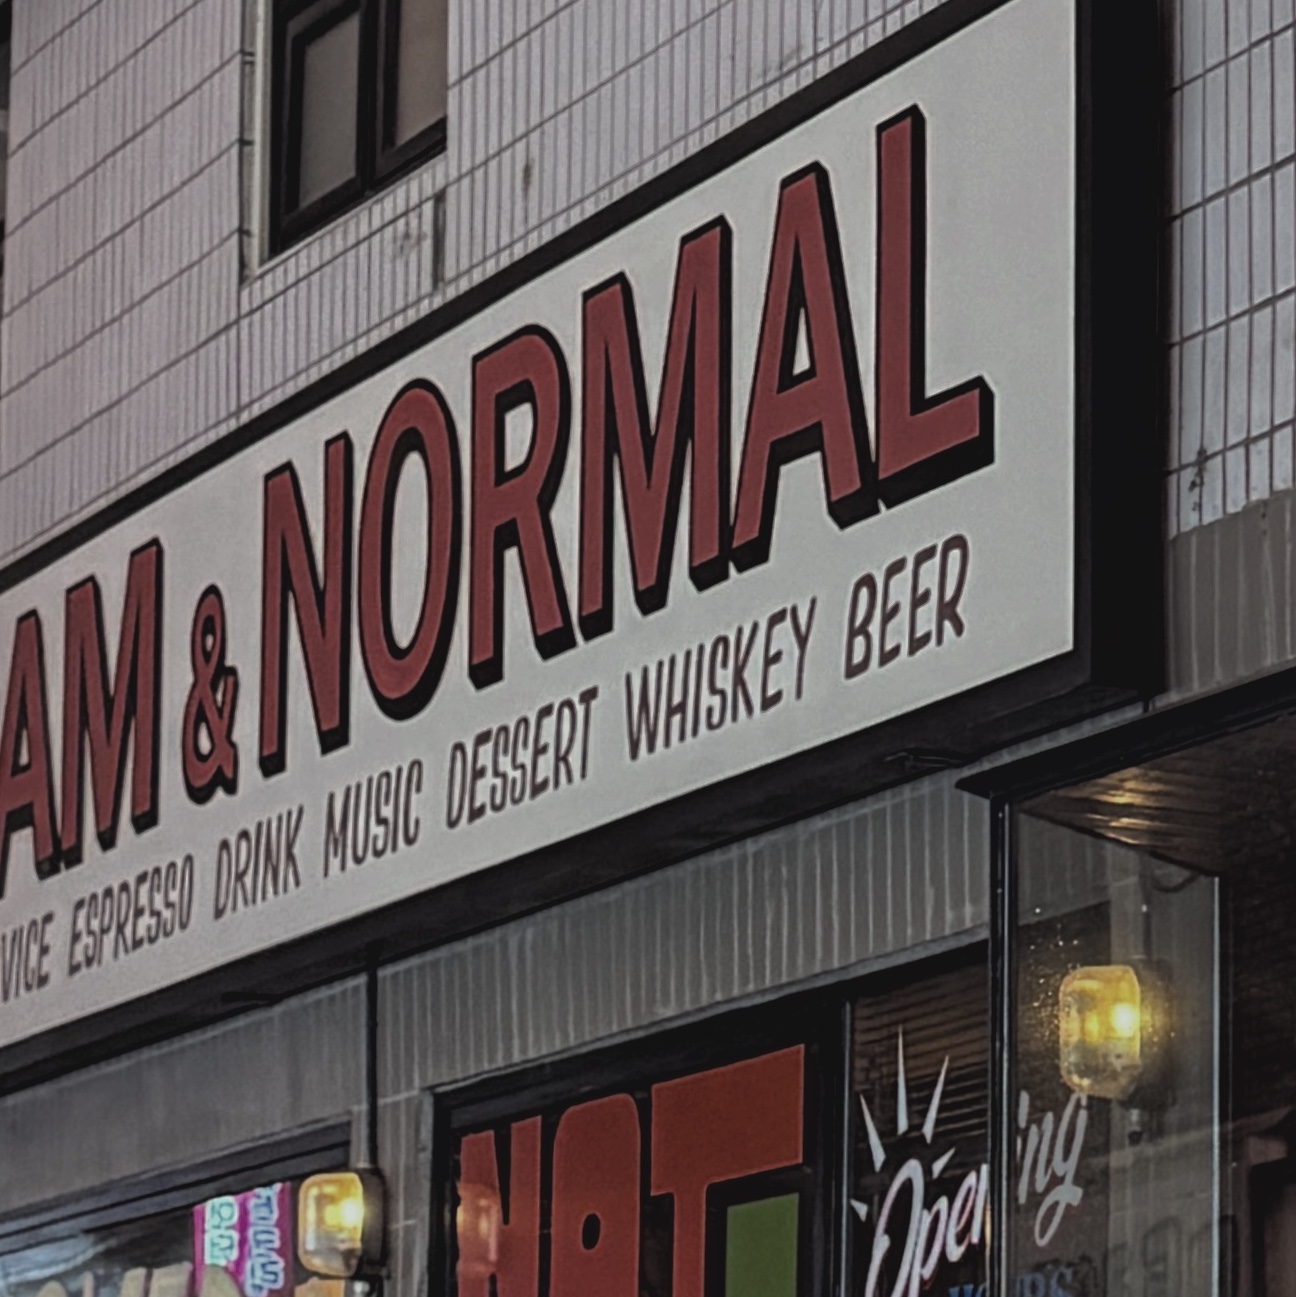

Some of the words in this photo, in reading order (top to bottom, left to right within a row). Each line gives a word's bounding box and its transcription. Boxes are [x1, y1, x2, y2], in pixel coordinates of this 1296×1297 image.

[182, 584, 239, 805] &
[258, 103, 995, 779] NORMAL
[67, 853, 194, 978] ESPRESSO
[213, 804, 303, 921] DRINK
[323, 759, 423, 879] MUSIC
[445, 685, 598, 830] DESSERT
[625, 596, 816, 761] WHISKEY
[844, 533, 970, 680] BEER
